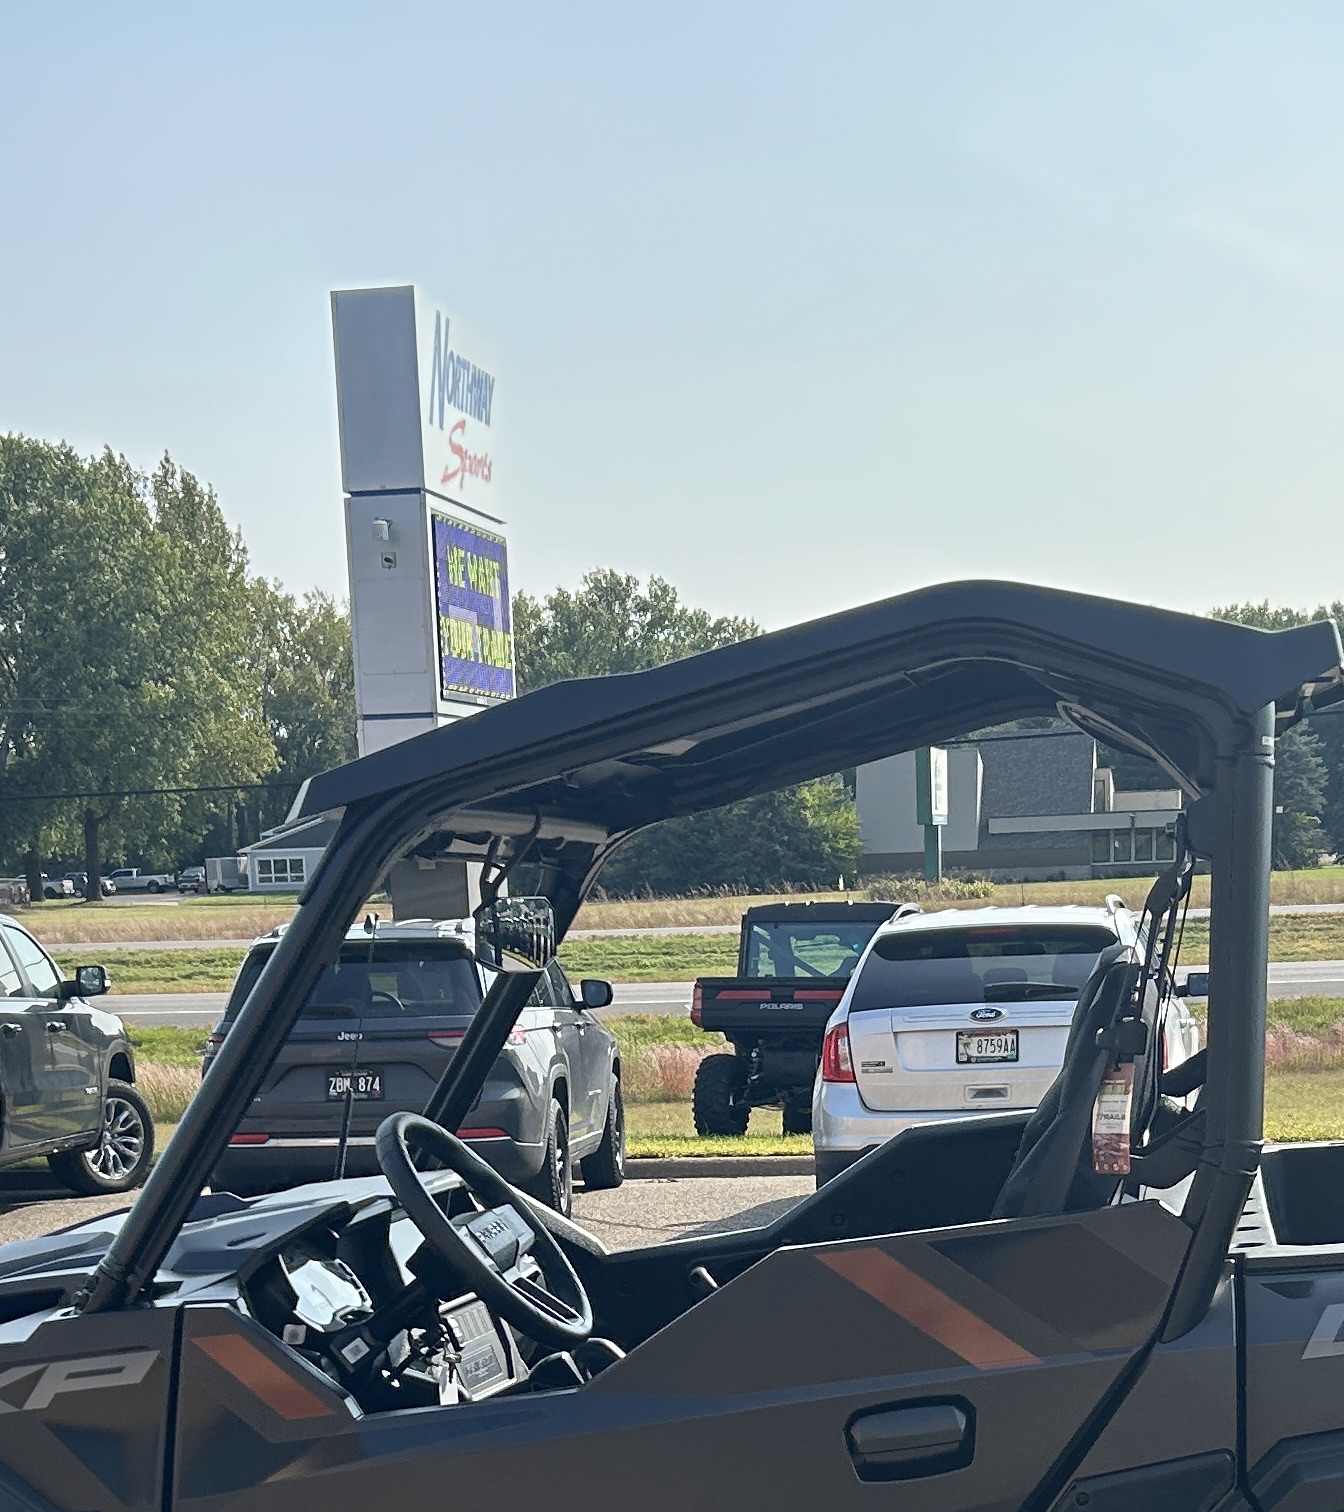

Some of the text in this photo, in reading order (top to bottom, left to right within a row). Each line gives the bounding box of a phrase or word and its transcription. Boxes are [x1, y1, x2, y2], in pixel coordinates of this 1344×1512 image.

[441, 418, 492, 490] Sports
[976, 1037, 1016, 1054] 8759AA
[358, 1076, 380, 1092] 874
